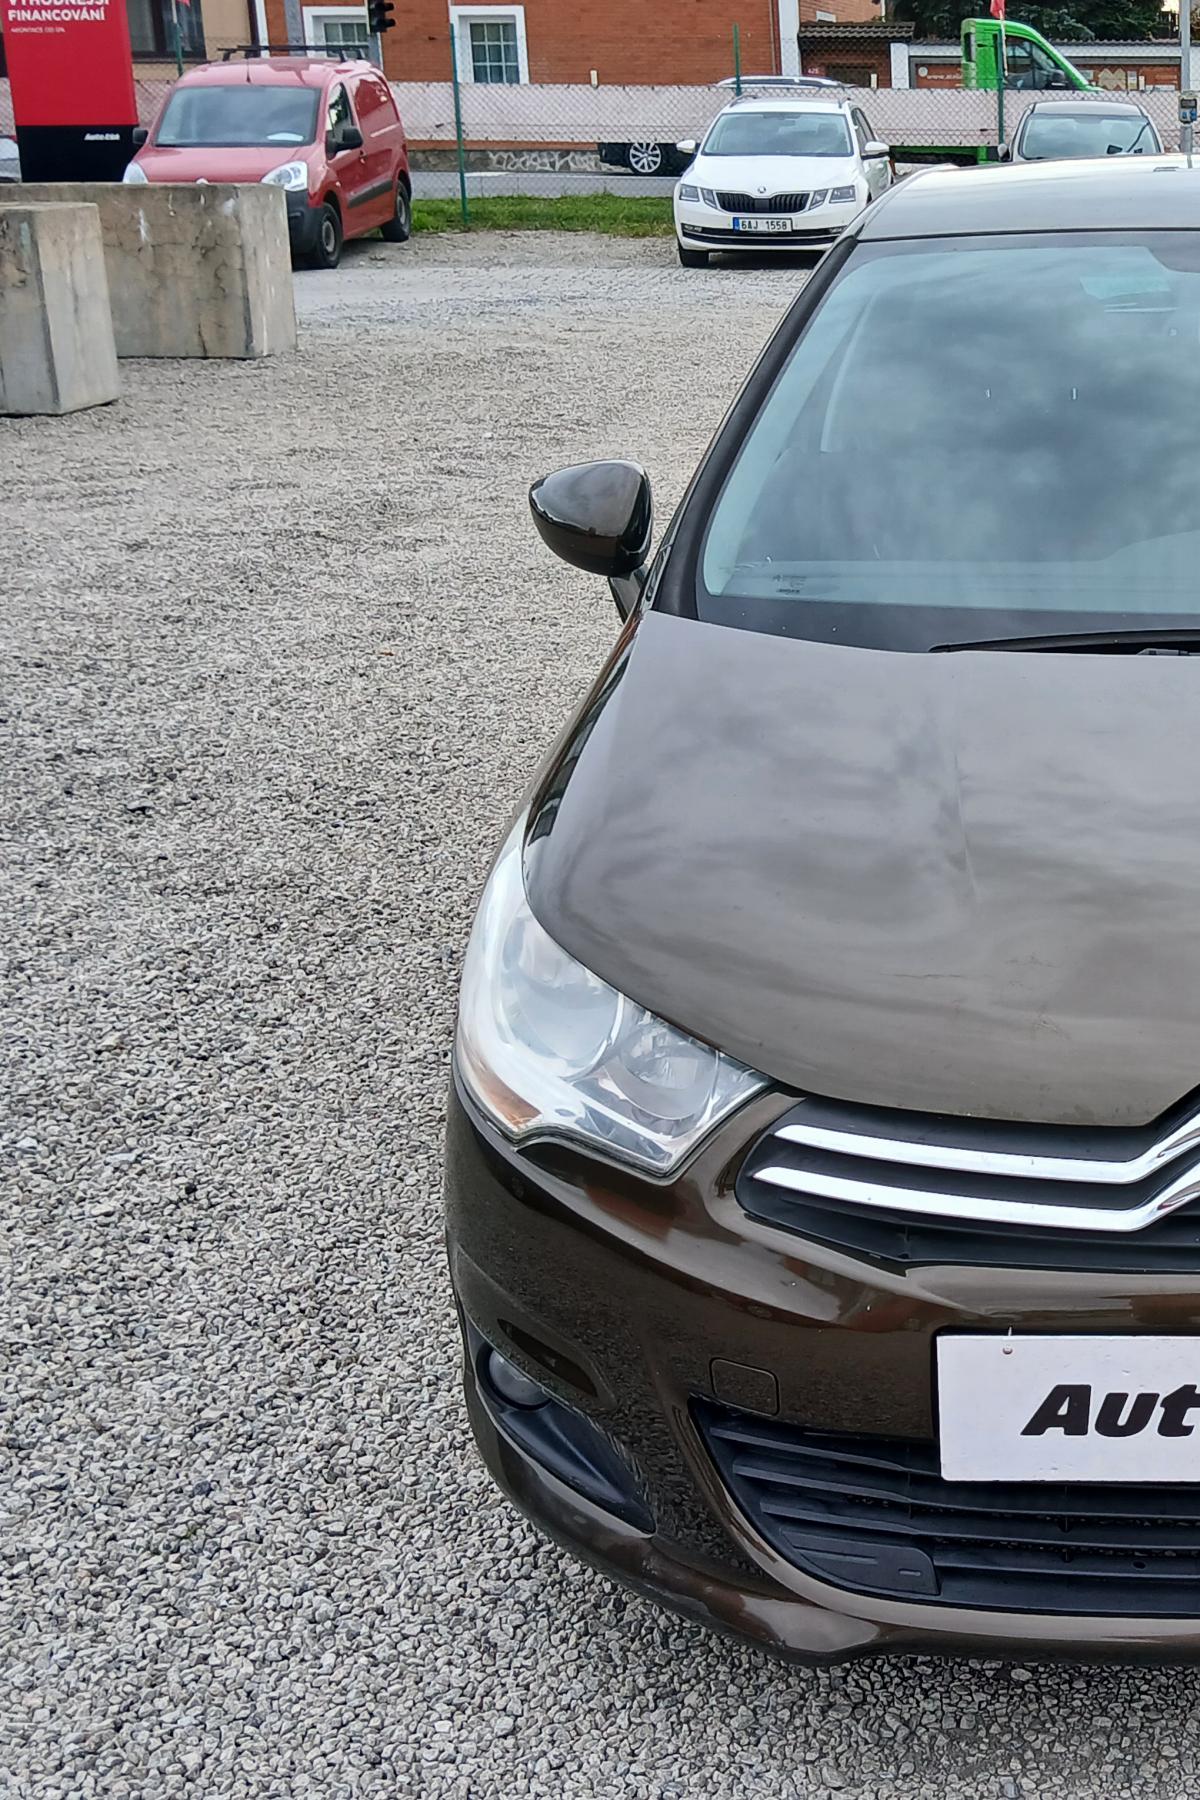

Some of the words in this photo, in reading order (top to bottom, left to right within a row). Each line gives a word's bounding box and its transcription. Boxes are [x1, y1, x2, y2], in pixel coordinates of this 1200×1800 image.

[8, 7, 105, 21] FINANCOVÁNÍ
[741, 220, 759, 230] 6AJ
[766, 220, 788, 230] 1558
